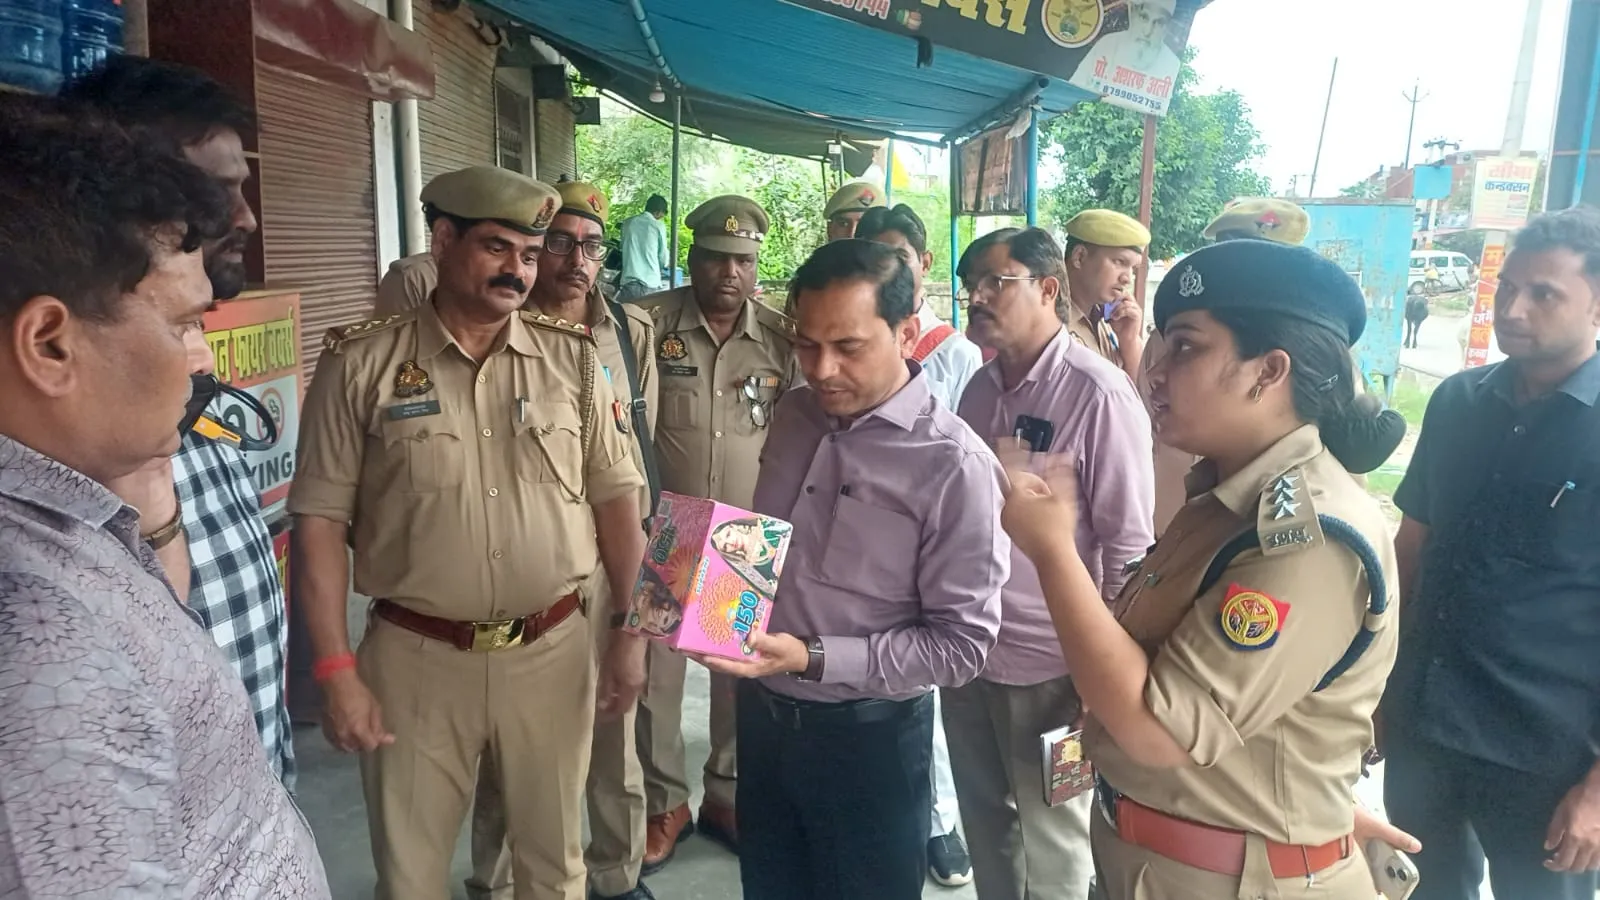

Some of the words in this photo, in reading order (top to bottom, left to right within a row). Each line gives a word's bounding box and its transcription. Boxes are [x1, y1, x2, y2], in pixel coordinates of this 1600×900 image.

[1102, 85, 1162, 110] 8799052755
[1146, 76, 1172, 98] अली
[231, 323, 267, 380] फायर
[733, 590, 760, 633] 150
